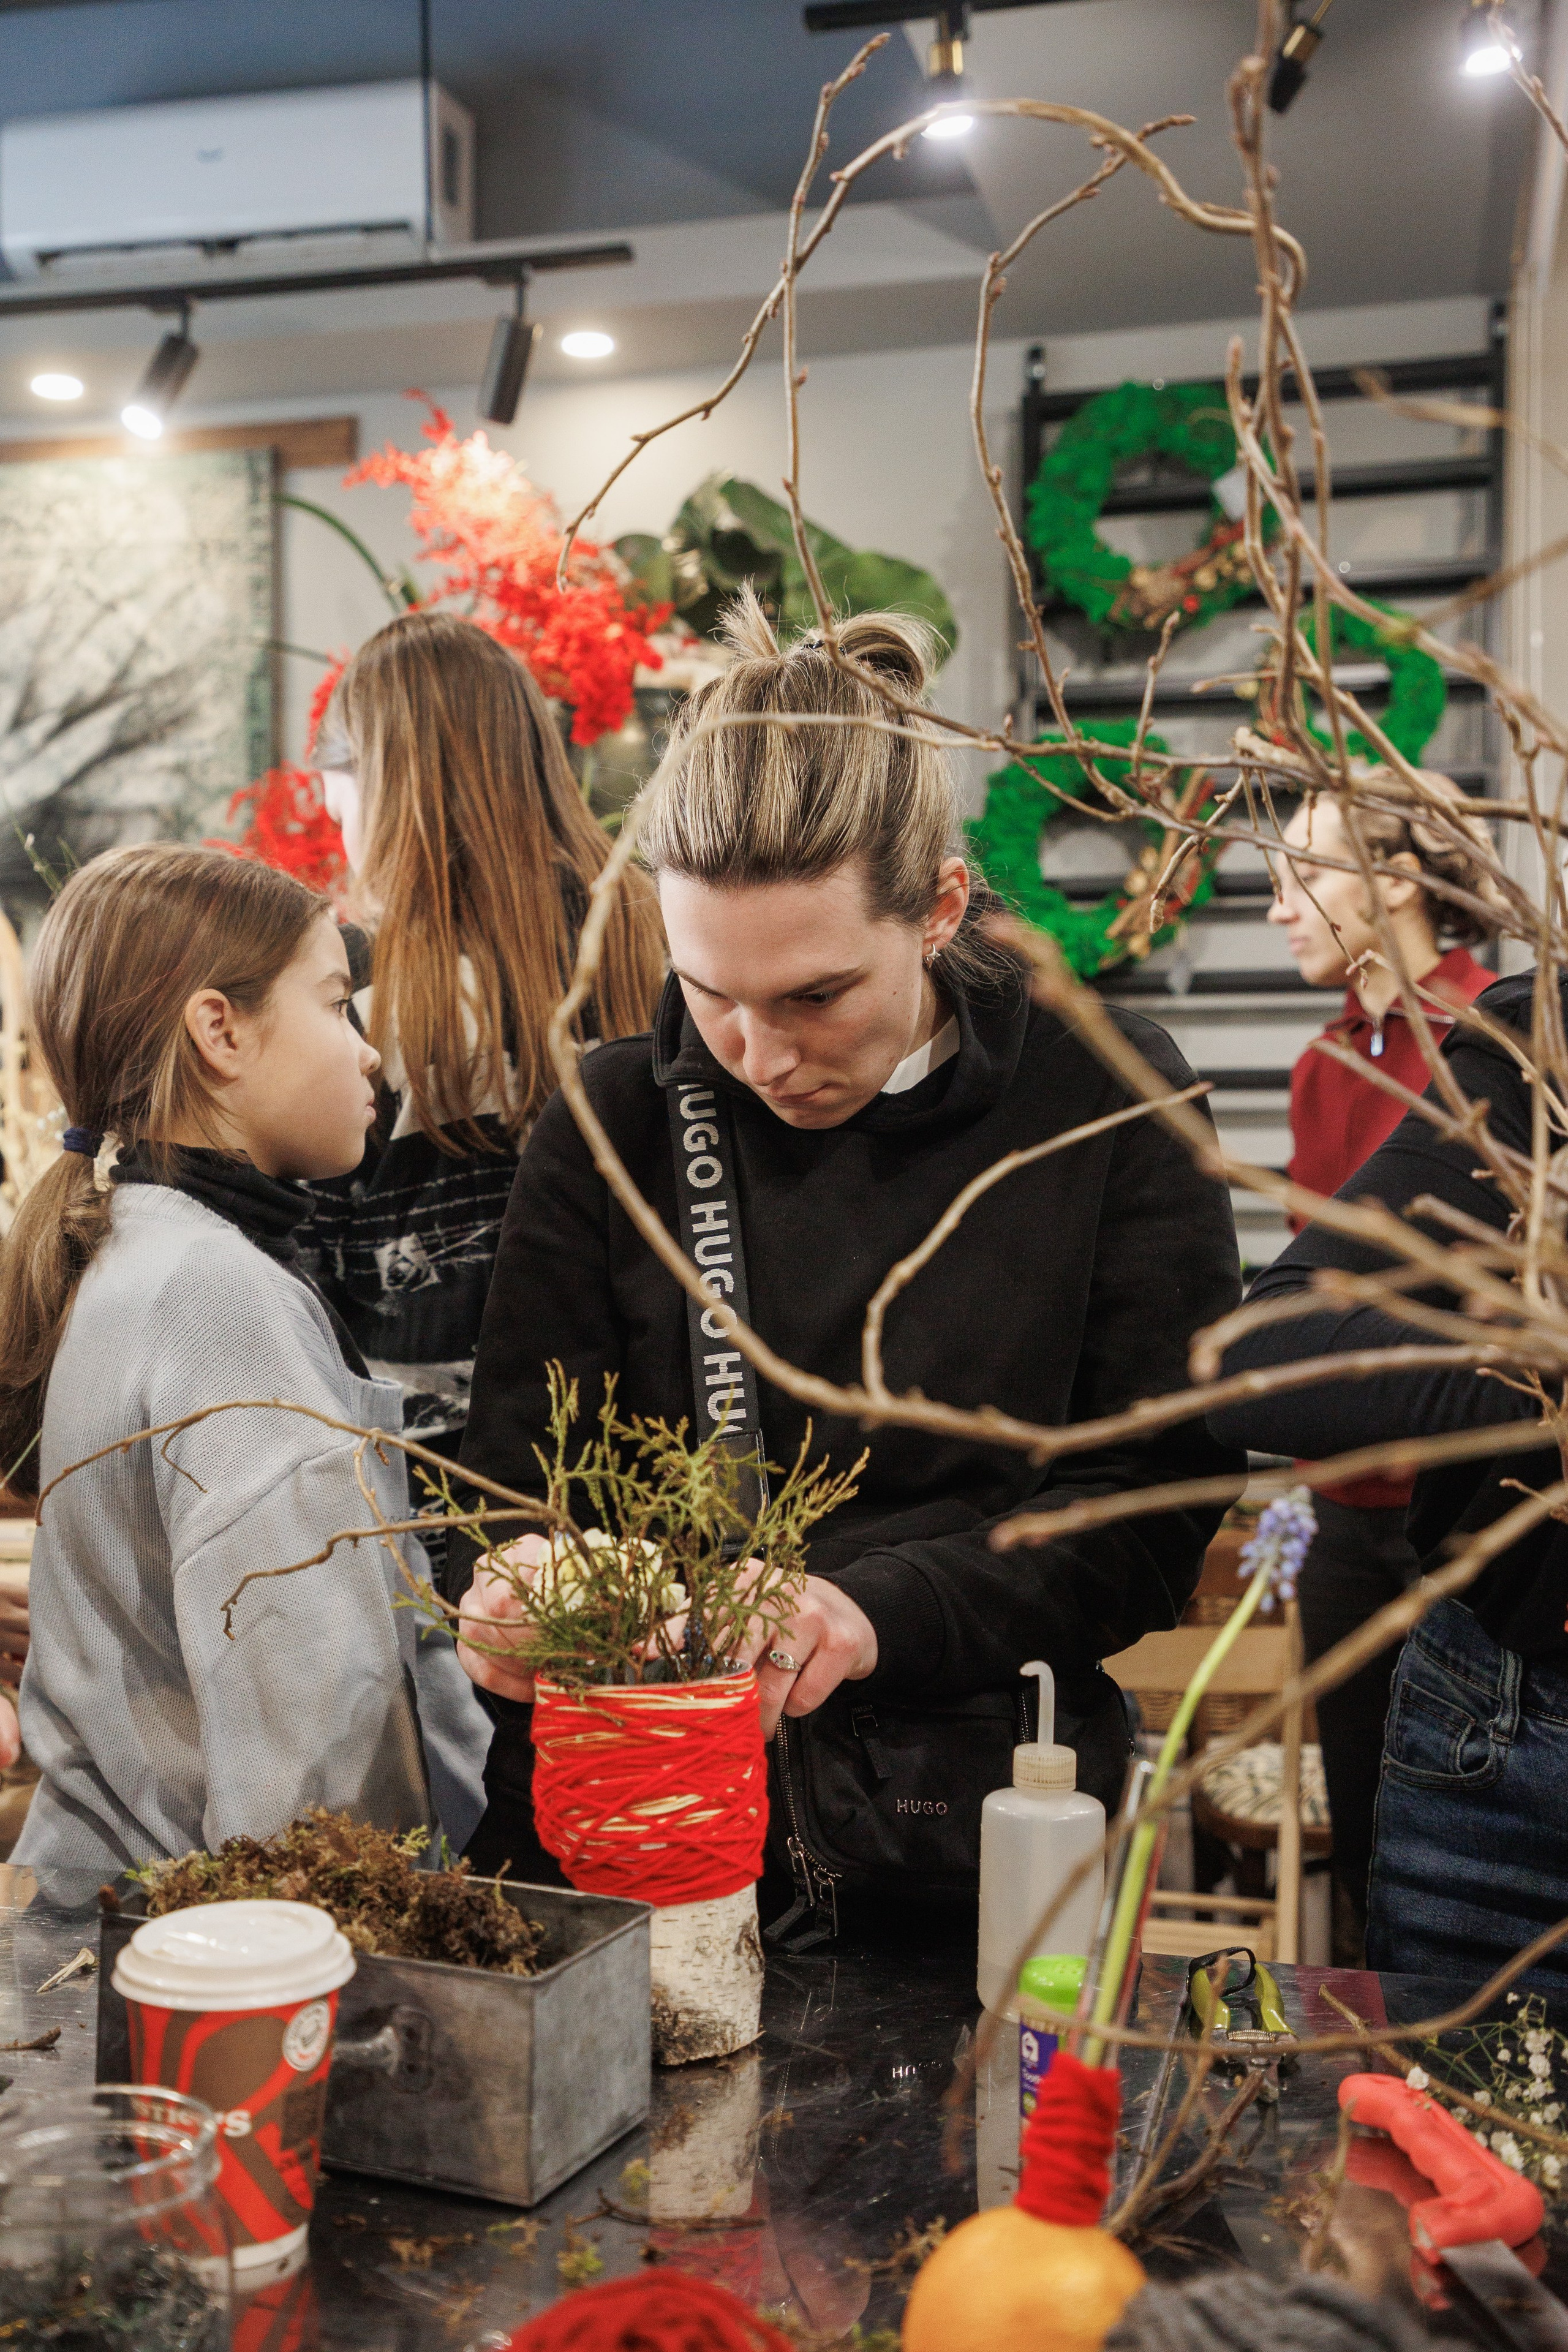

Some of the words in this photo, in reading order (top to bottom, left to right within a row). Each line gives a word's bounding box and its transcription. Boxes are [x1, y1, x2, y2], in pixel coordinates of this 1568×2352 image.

[677, 1084, 723, 1188] UGO
[690, 1200, 737, 1338] HUGO
[703, 1352, 746, 1433] HU
[897, 1799, 948, 1815] HUGO
